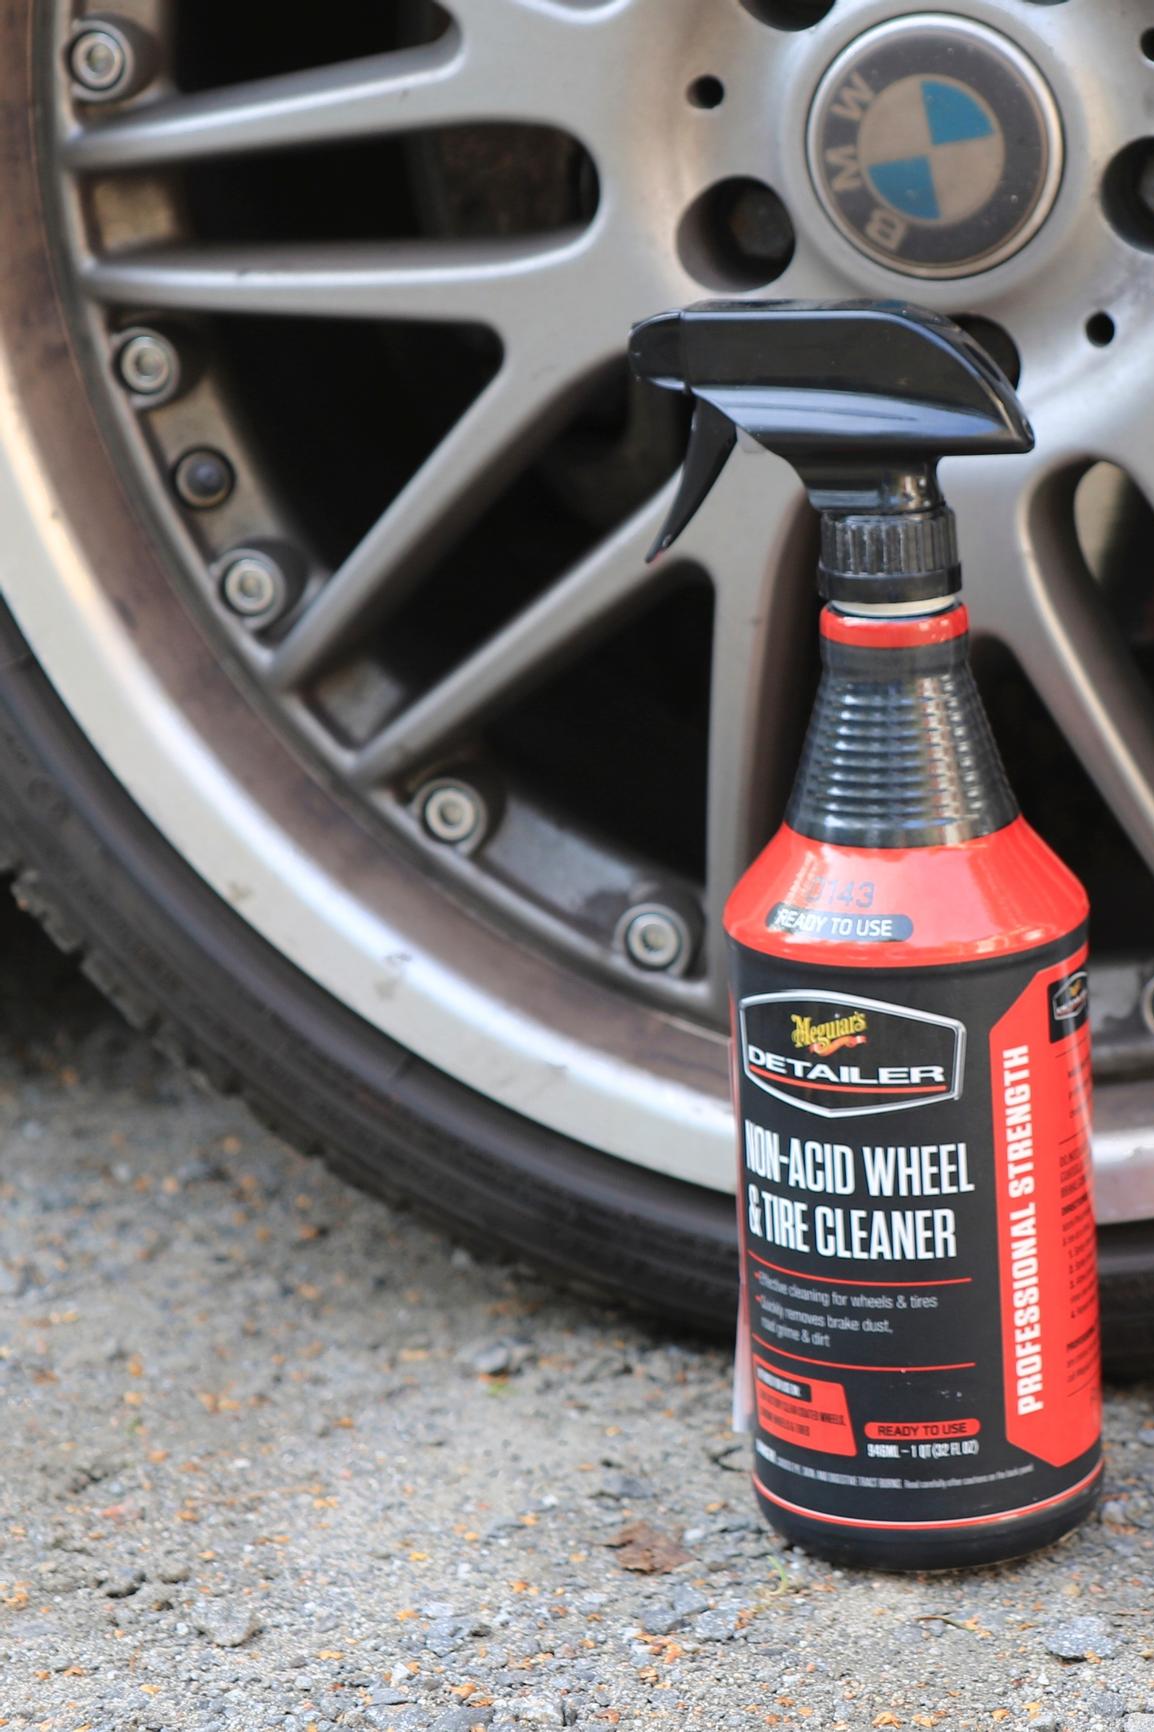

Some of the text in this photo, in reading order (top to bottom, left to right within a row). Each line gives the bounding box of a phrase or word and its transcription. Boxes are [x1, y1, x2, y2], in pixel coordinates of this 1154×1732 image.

[826, 71, 908, 251] BMW
[774, 908, 893, 937] READY TO USE
[790, 1011, 867, 1048] Meguiar's
[748, 1045, 945, 1084] DETAILER
[745, 1119, 975, 1197] NON-ACID WHEEL
[748, 1183, 957, 1261] & TIRE CLEANER
[1003, 1045, 1044, 1416] PROFESSIONAL STRENGTH
[788, 1284, 830, 1307] cleaning
[832, 1291, 848, 1306] for
[851, 1294, 894, 1309] wheels
[896, 1295, 907, 1309] &
[910, 1294, 938, 1309] tires
[784, 1307, 825, 1327] removes
[826, 1315, 860, 1331] brake
[862, 1318, 893, 1334] dust,
[801, 1327, 811, 1343] &
[811, 1331, 831, 1347] dirt
[878, 1422, 967, 1437] READY TO USE
